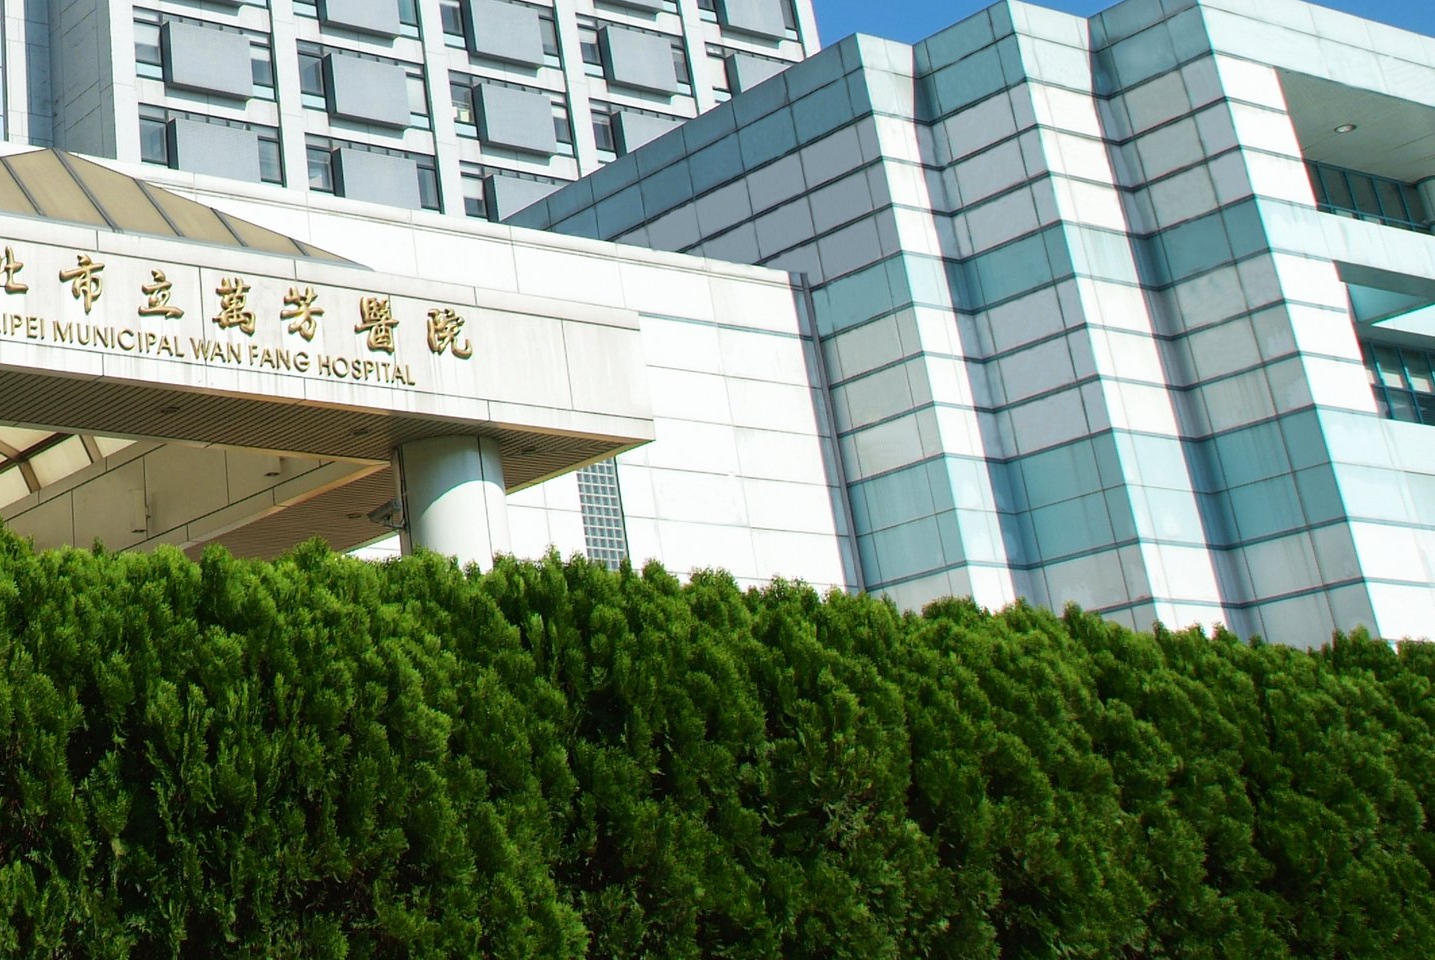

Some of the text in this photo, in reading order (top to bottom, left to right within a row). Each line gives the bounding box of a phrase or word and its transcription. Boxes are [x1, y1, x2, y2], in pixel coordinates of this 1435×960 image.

[53, 320, 185, 357] MUNICIPAL
[190, 337, 242, 364] WAN
[249, 345, 310, 373] FANG
[318, 354, 416, 386] HOSPITAL
